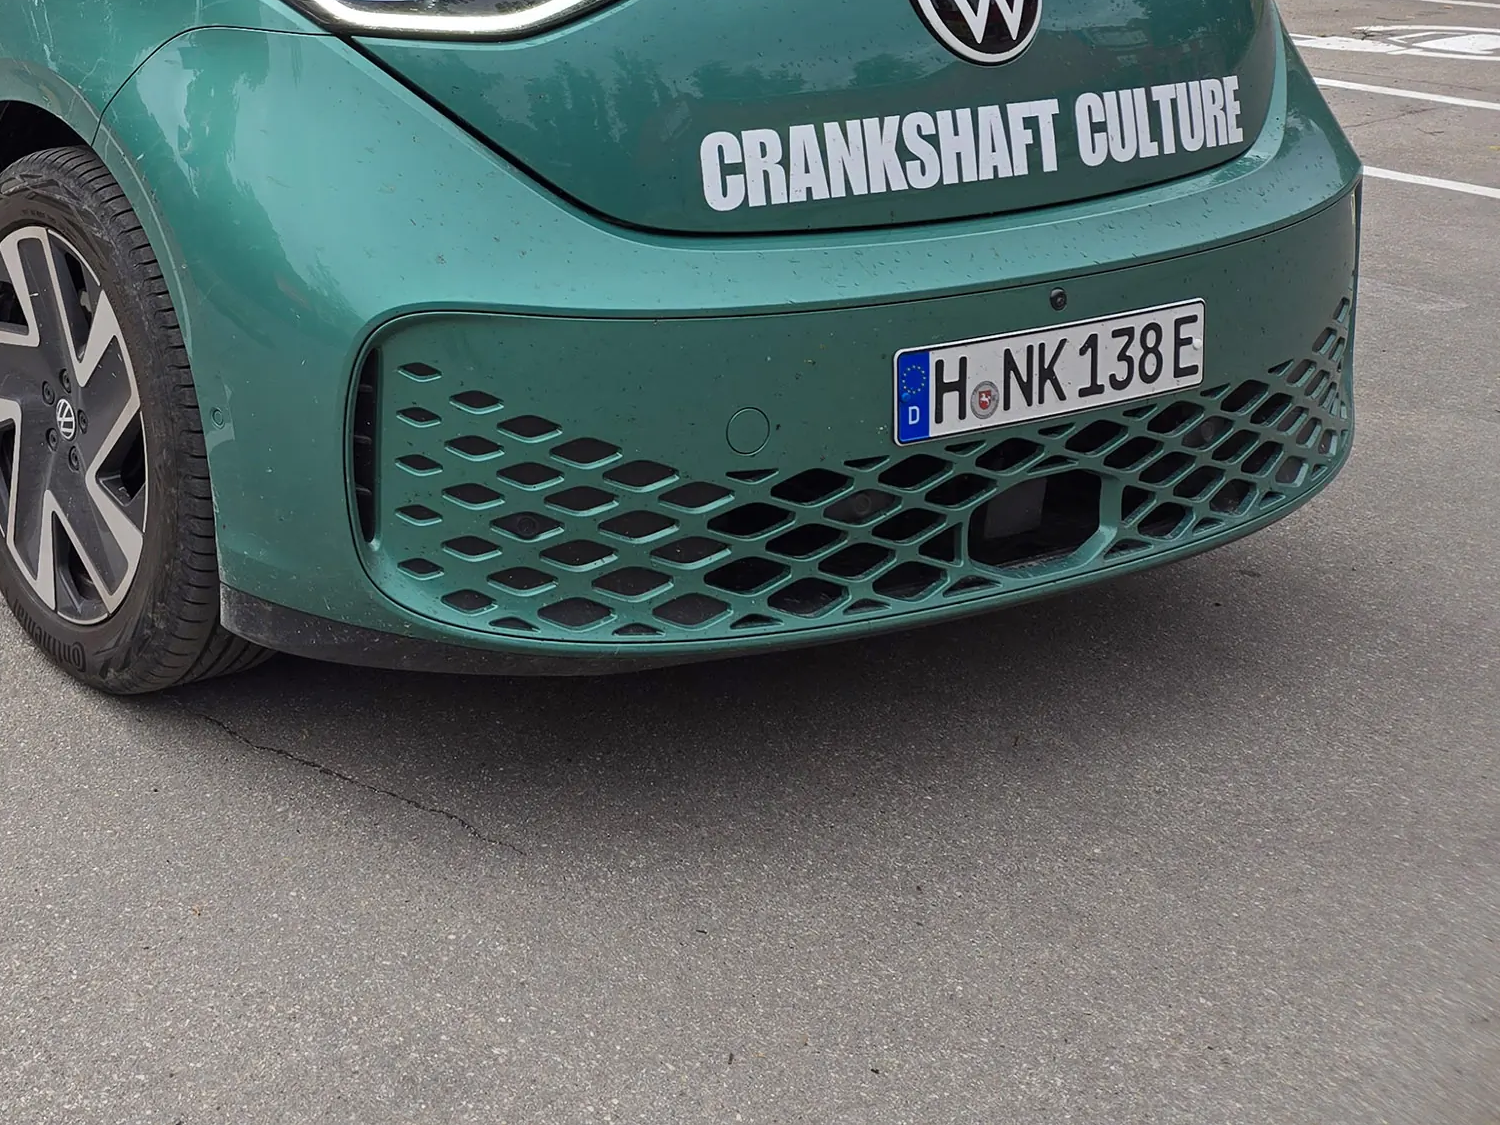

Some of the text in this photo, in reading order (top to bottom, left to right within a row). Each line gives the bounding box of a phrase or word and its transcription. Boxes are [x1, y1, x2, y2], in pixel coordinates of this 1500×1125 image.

[699, 74, 1244, 212] CRANKSHAFT CULTURE
[908, 405, 920, 425] D
[934, 355, 968, 425] H
